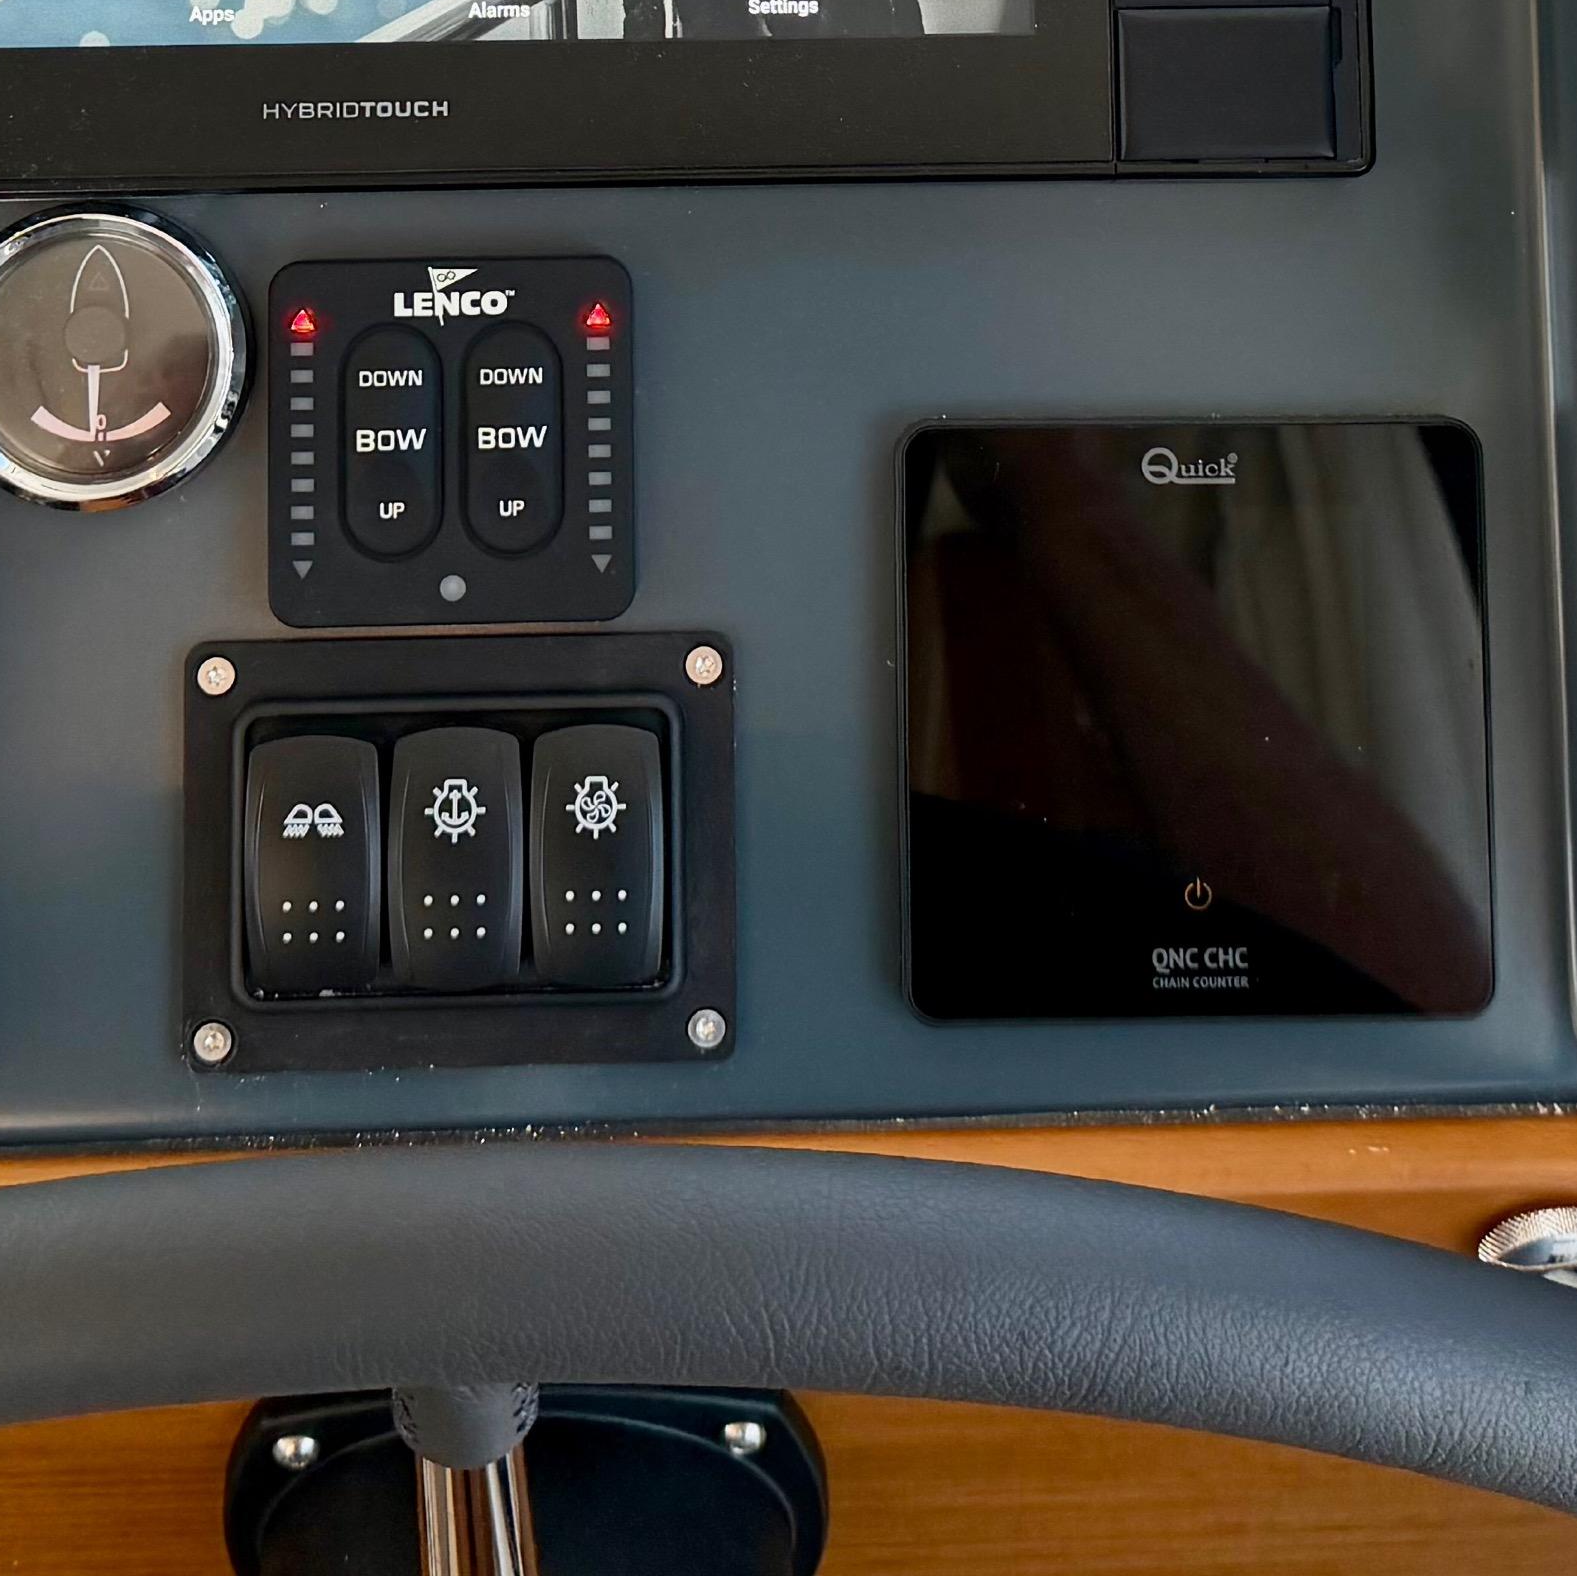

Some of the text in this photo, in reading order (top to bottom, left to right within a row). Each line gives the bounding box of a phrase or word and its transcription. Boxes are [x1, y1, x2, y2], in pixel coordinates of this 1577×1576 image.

[189, 6, 235, 26] Apps
[469, 3, 530, 19] Alarms
[262, 100, 450, 120] HYBRIDTOUCH
[359, 367, 543, 387] DOWN DOWN
[355, 426, 547, 452] BOW BOW
[1141, 447, 1238, 485] Quick
[379, 500, 525, 519] UP UP
[1152, 946, 1249, 974] QNC CHC
[1152, 975, 1250, 989] CHAIN COUNTER
